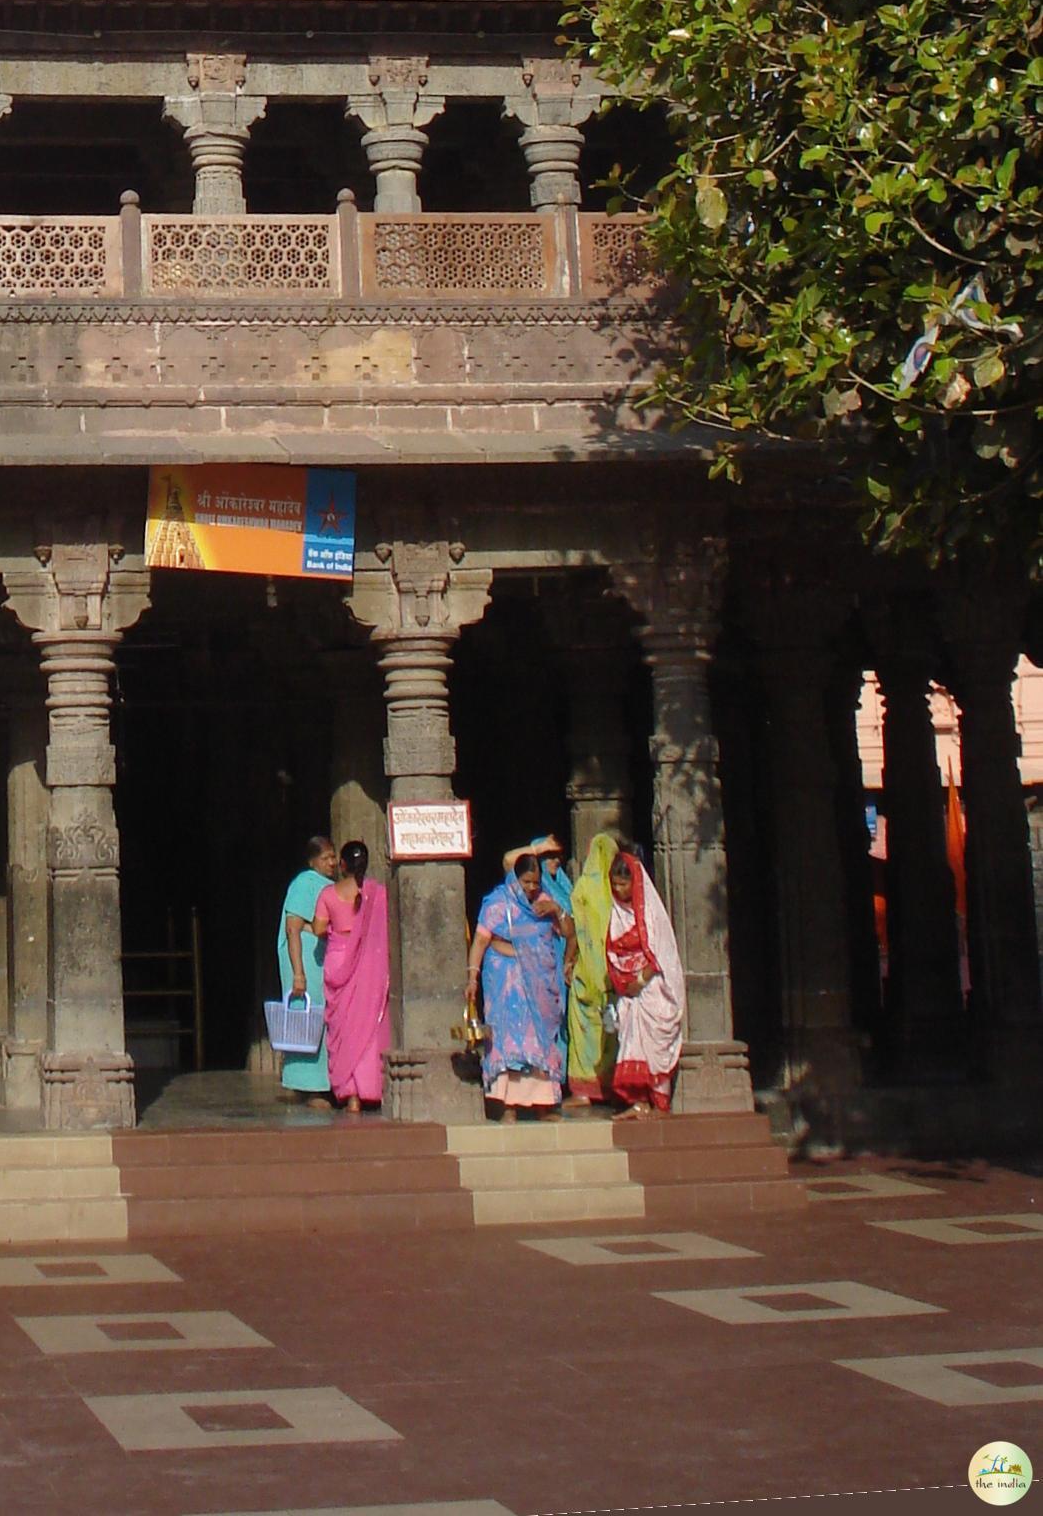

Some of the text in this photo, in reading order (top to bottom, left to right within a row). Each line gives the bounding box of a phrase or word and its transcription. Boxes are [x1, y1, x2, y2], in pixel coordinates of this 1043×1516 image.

[197, 489, 211, 508] श्री
[269, 495, 302, 517] महादेव
[307, 560, 353, 572] Bank of India
